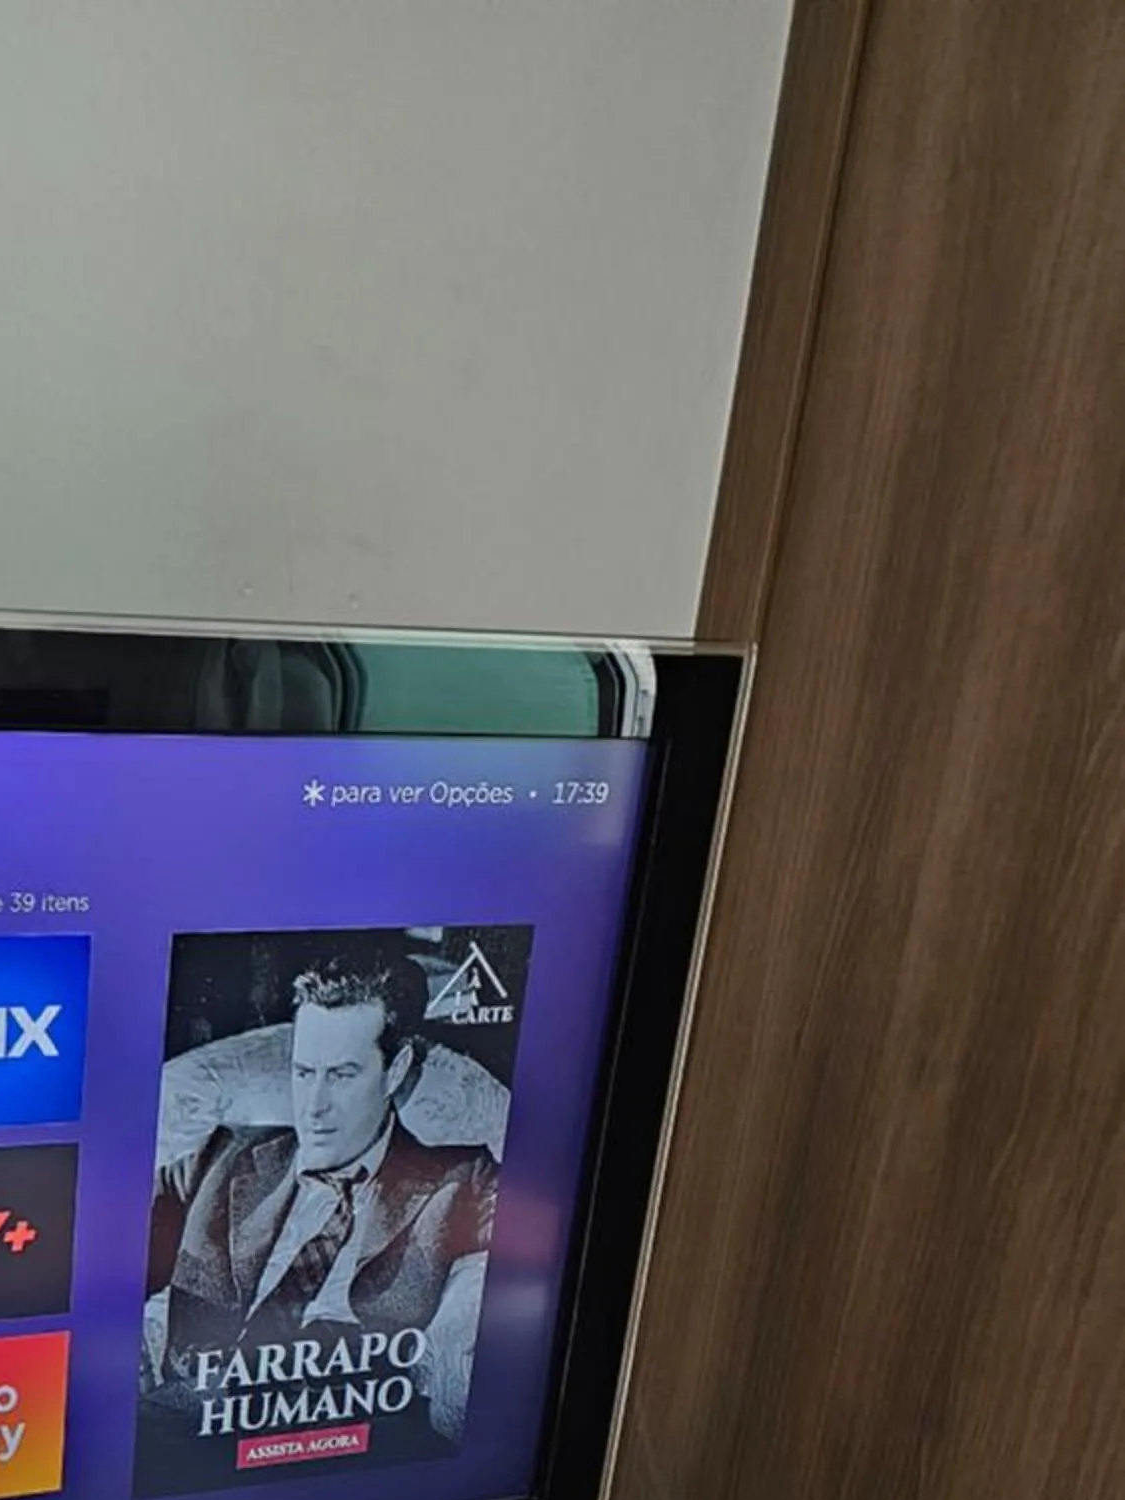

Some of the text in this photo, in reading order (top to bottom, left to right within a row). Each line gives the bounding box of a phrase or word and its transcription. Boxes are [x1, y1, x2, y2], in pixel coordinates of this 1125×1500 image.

[331, 781, 609, 808] para ver Opções 17:39
[9, 893, 35, 913] 39
[41, 892, 90, 913] itens
[451, 1004, 514, 1024] CARTE
[194, 1326, 428, 1393] FARRAPO
[198, 1375, 413, 1437] HUMANO
[246, 1433, 360, 1461] ASSISTA AGORA
